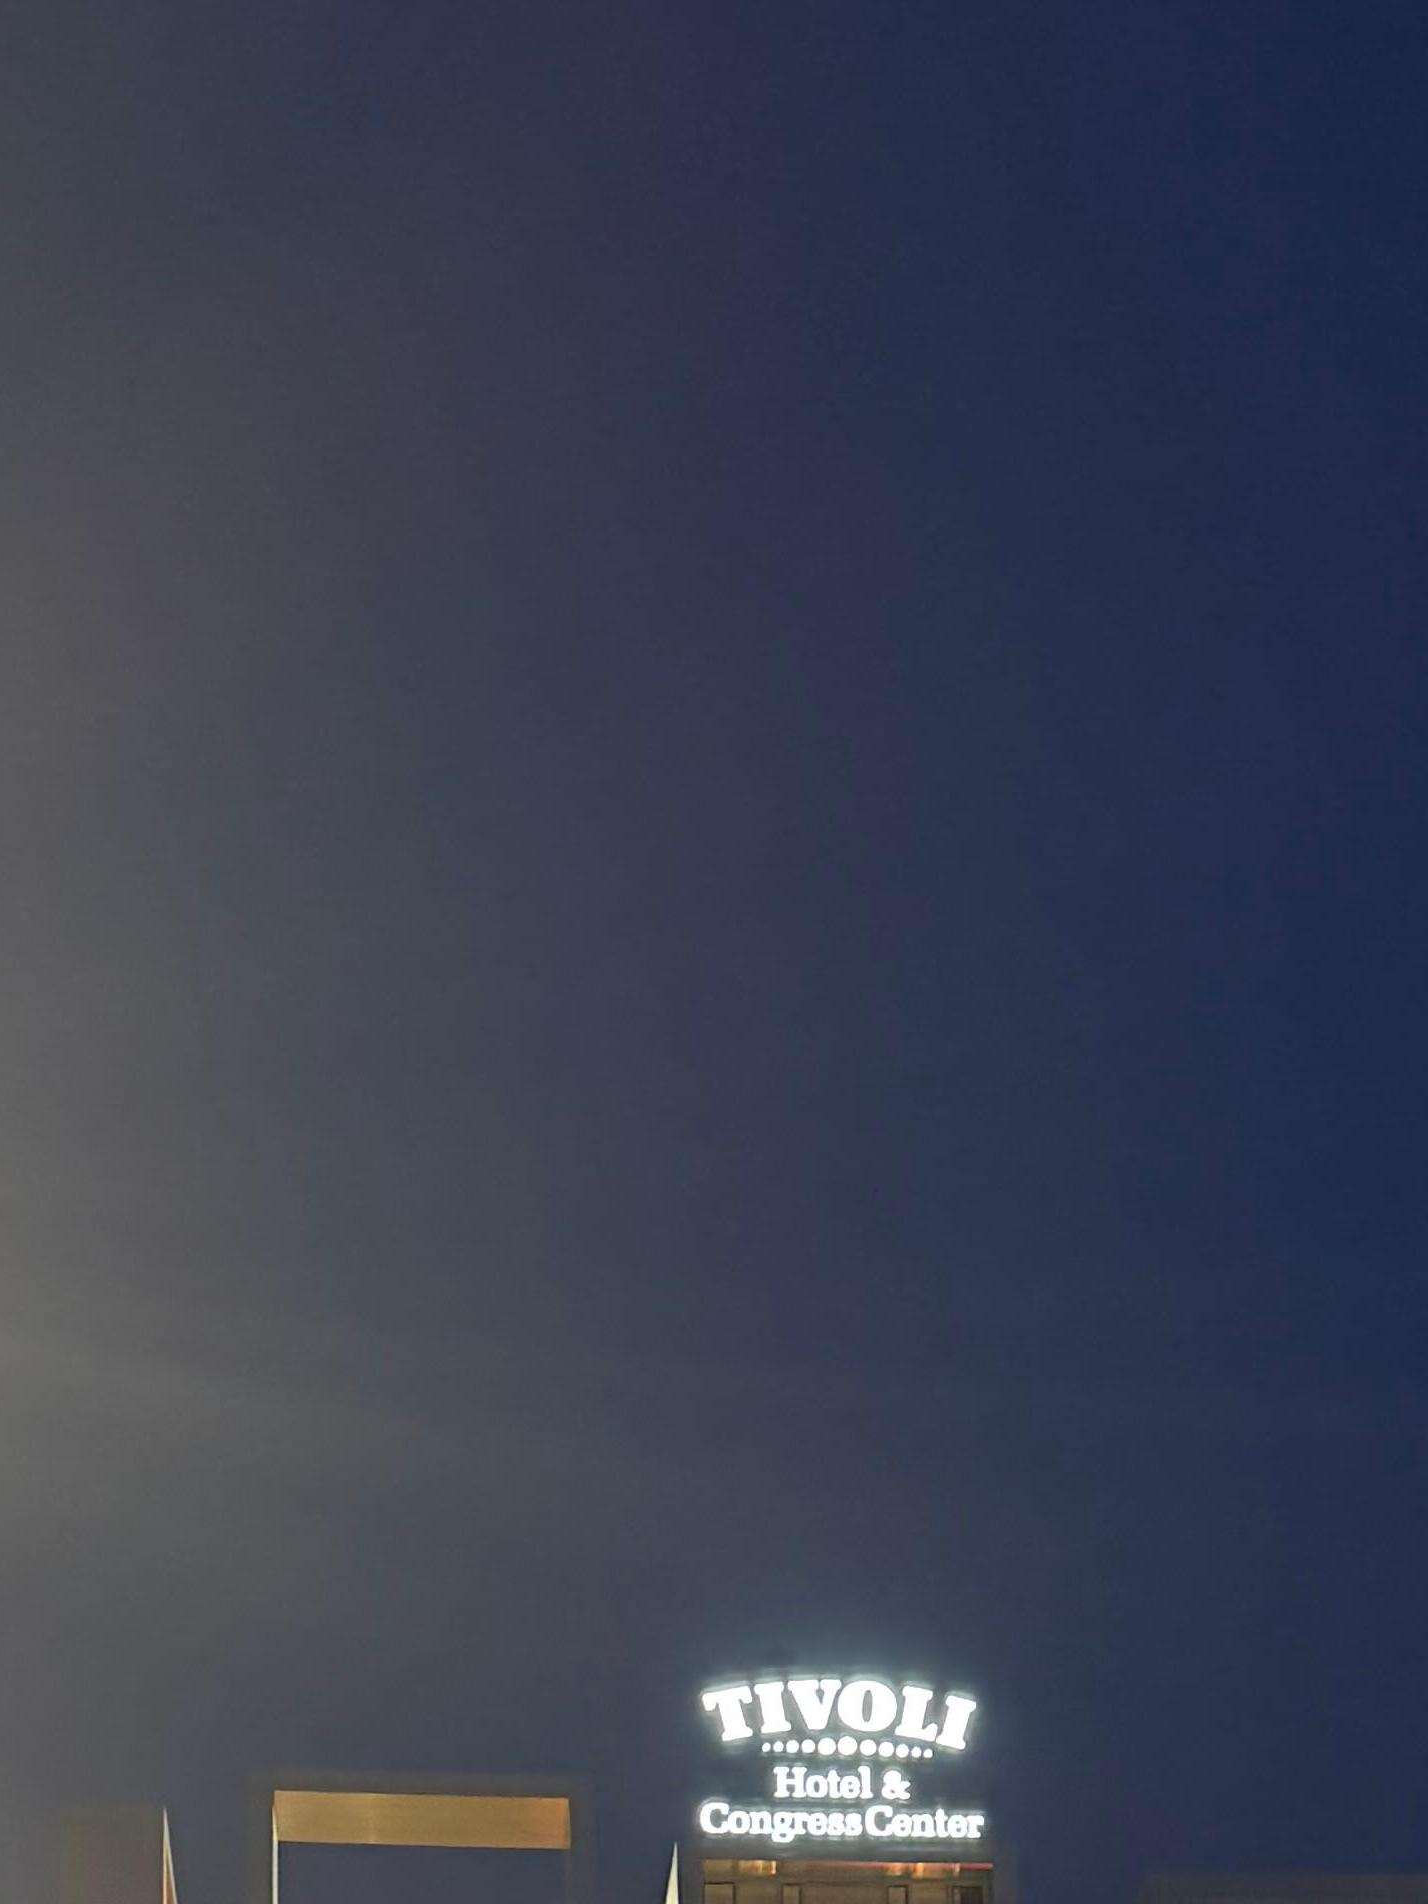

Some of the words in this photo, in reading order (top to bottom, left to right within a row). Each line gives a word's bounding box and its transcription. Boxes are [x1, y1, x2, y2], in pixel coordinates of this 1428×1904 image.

[702, 1679, 977, 1750] TIVOLI
[774, 1765, 873, 1799] Hotel
[882, 1770, 911, 1800] &
[700, 1802, 863, 1843] Congress
[866, 1805, 985, 1839] Center
